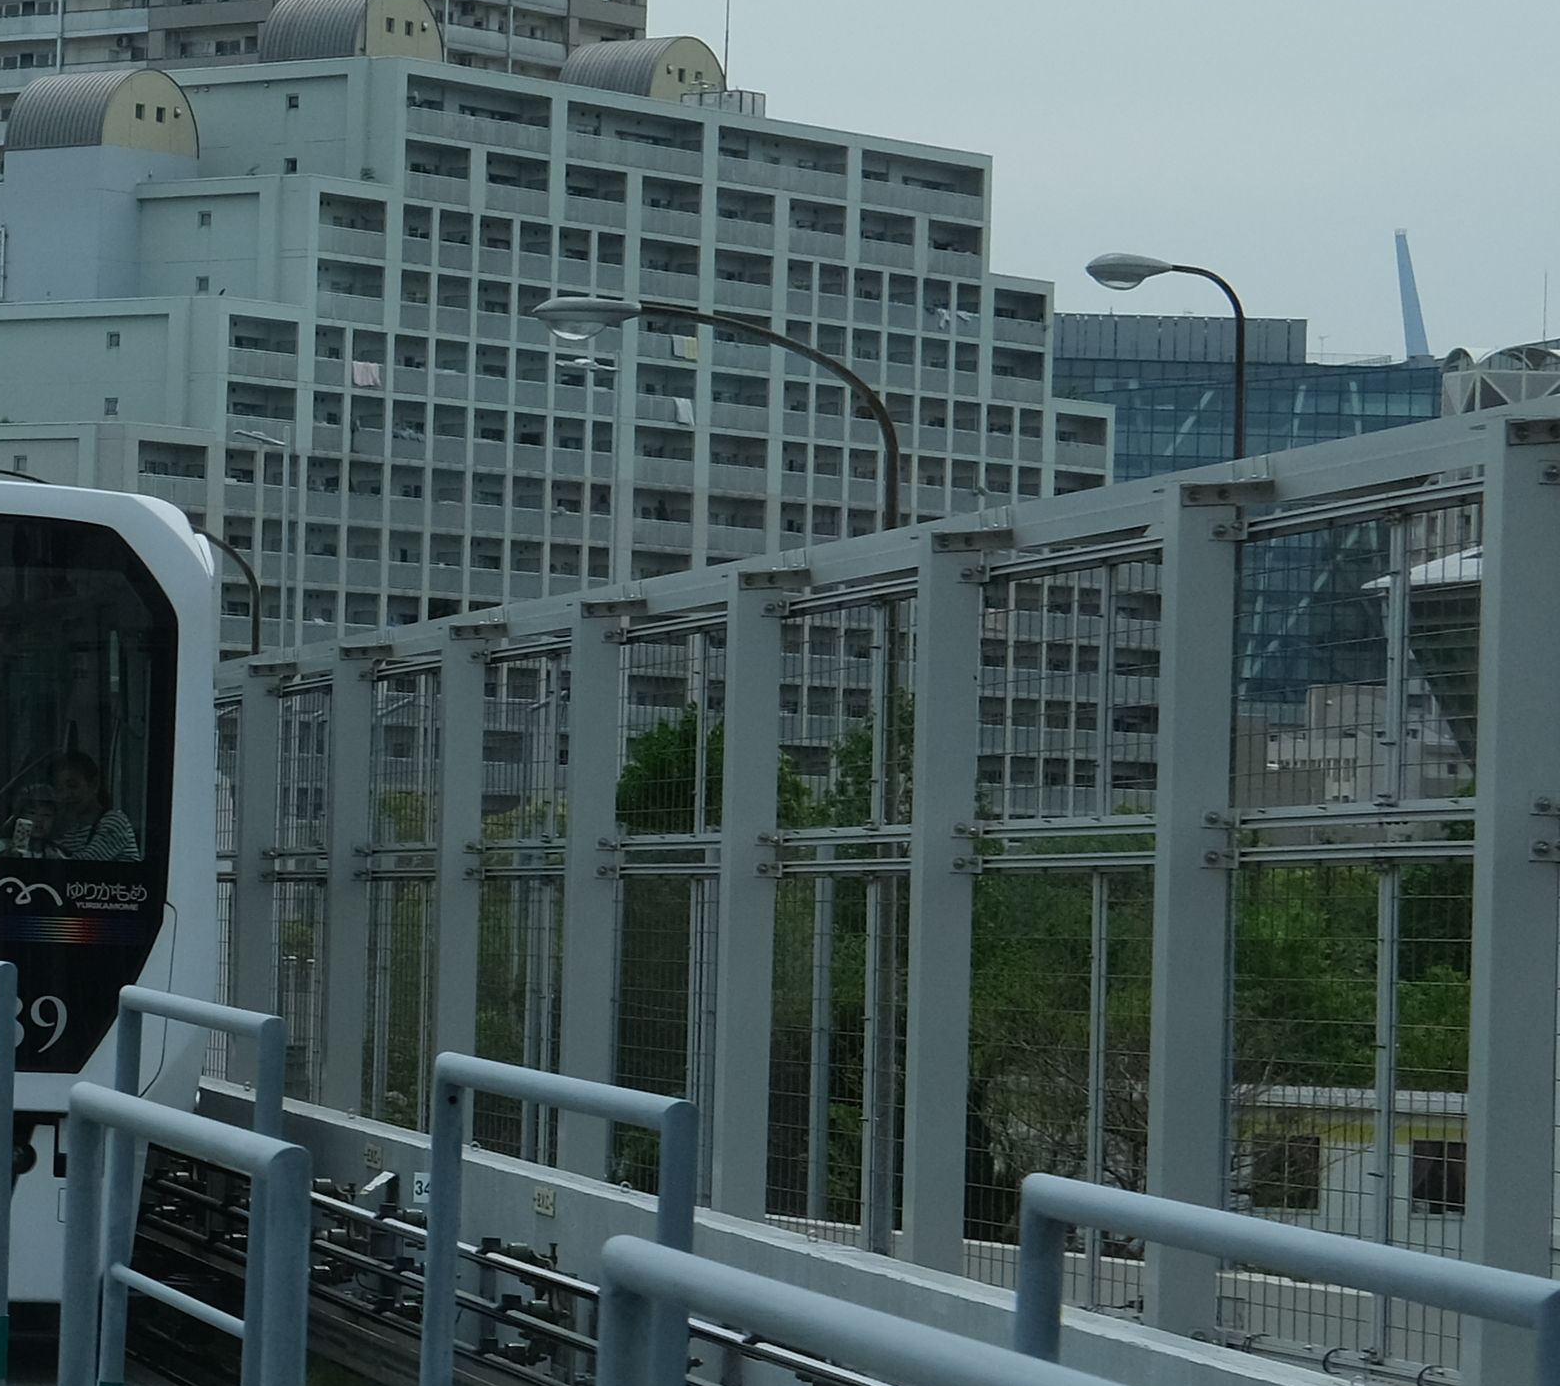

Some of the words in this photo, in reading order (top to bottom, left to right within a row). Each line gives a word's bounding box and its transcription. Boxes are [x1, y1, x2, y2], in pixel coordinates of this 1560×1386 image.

[66, 882, 148, 902] ゆりかもめ
[75, 901, 139, 911] YURIKAMOME
